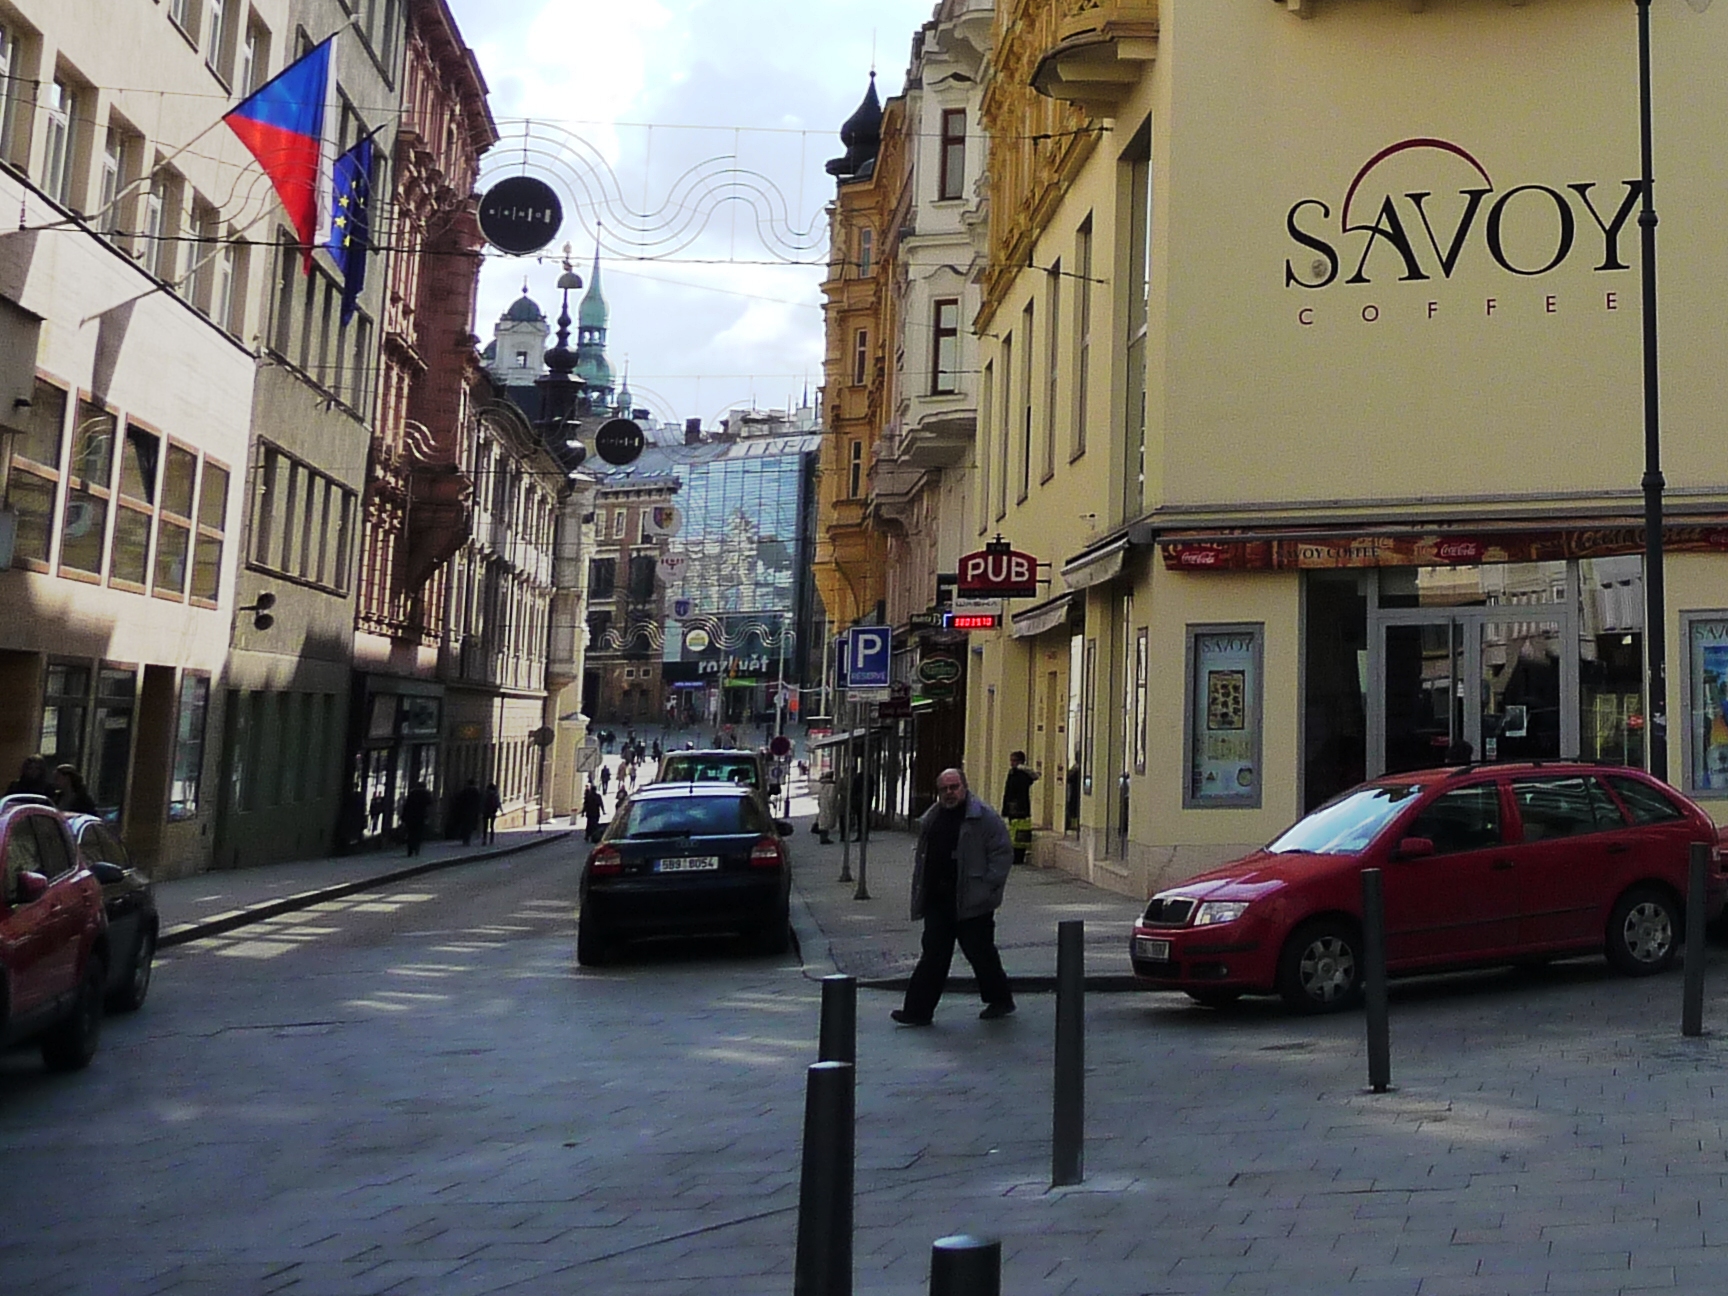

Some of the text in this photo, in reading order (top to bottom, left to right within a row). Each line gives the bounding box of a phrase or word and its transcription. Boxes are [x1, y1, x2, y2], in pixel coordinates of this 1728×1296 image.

[1285, 178, 1655, 289] SAVOY
[1299, 291, 1618, 326] COFFEE
[1440, 543, 1477, 557] Coca-Cola
[967, 555, 1029, 582] PUB
[857, 634, 882, 668] P
